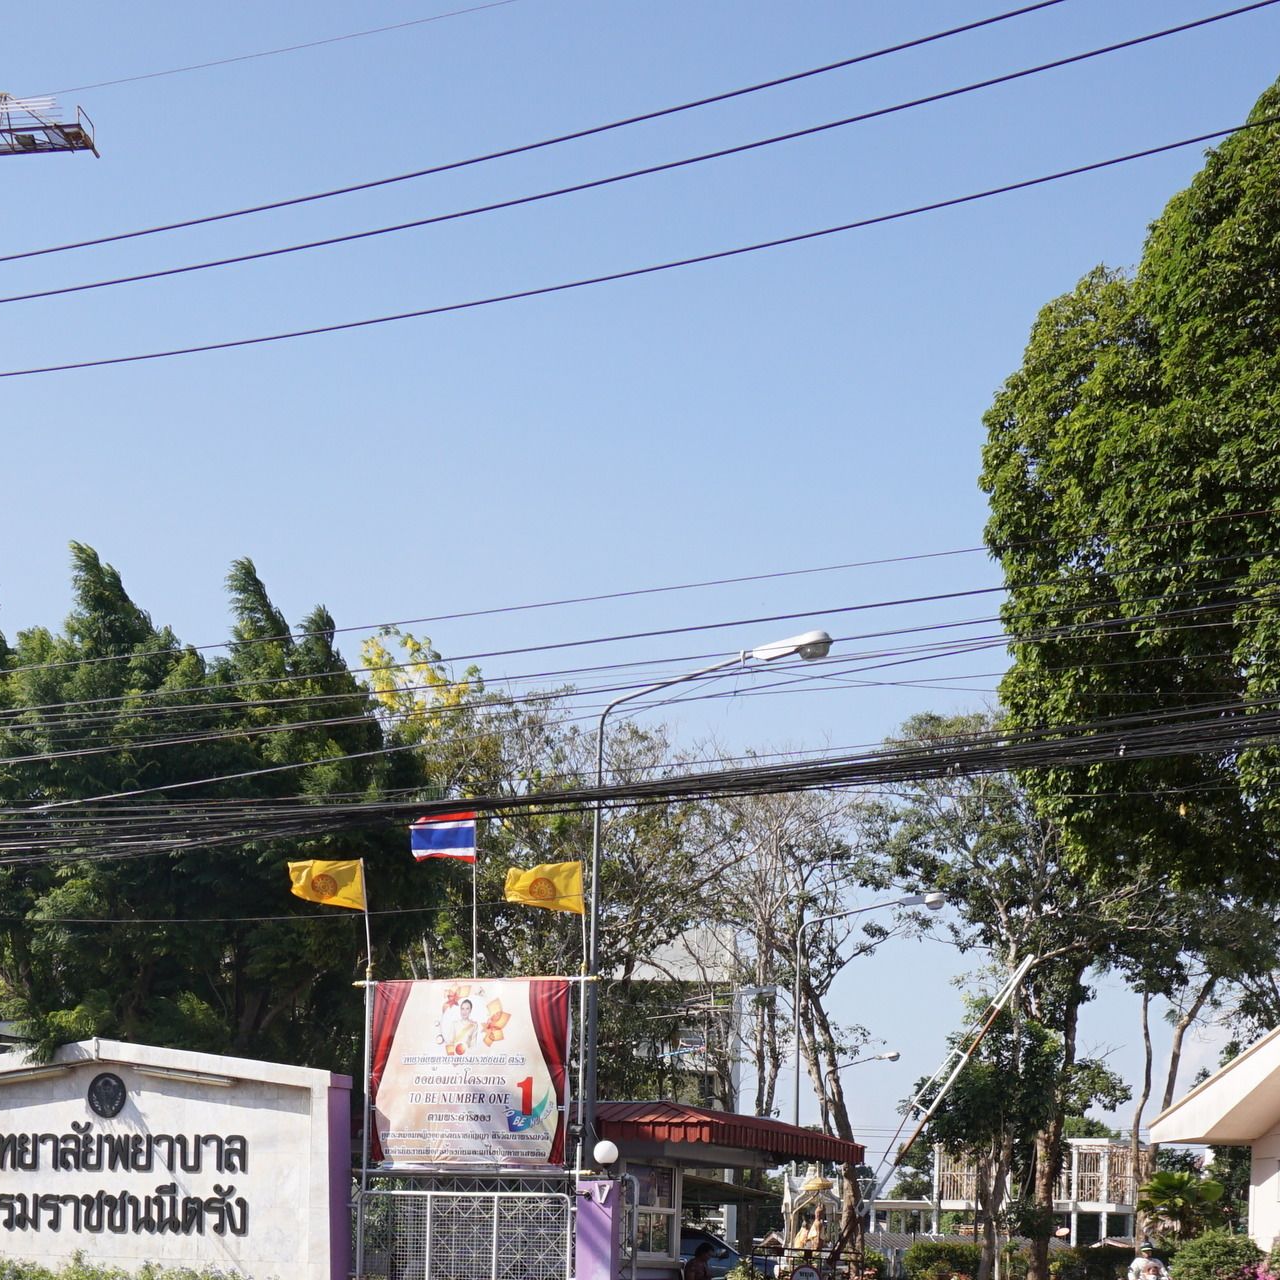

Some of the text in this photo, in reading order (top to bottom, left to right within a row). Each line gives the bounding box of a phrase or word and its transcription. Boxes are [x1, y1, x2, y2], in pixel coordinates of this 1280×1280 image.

[410, 1092, 510, 1105] TO BE NUMBER ONE
[512, 1115, 526, 1127] BE
